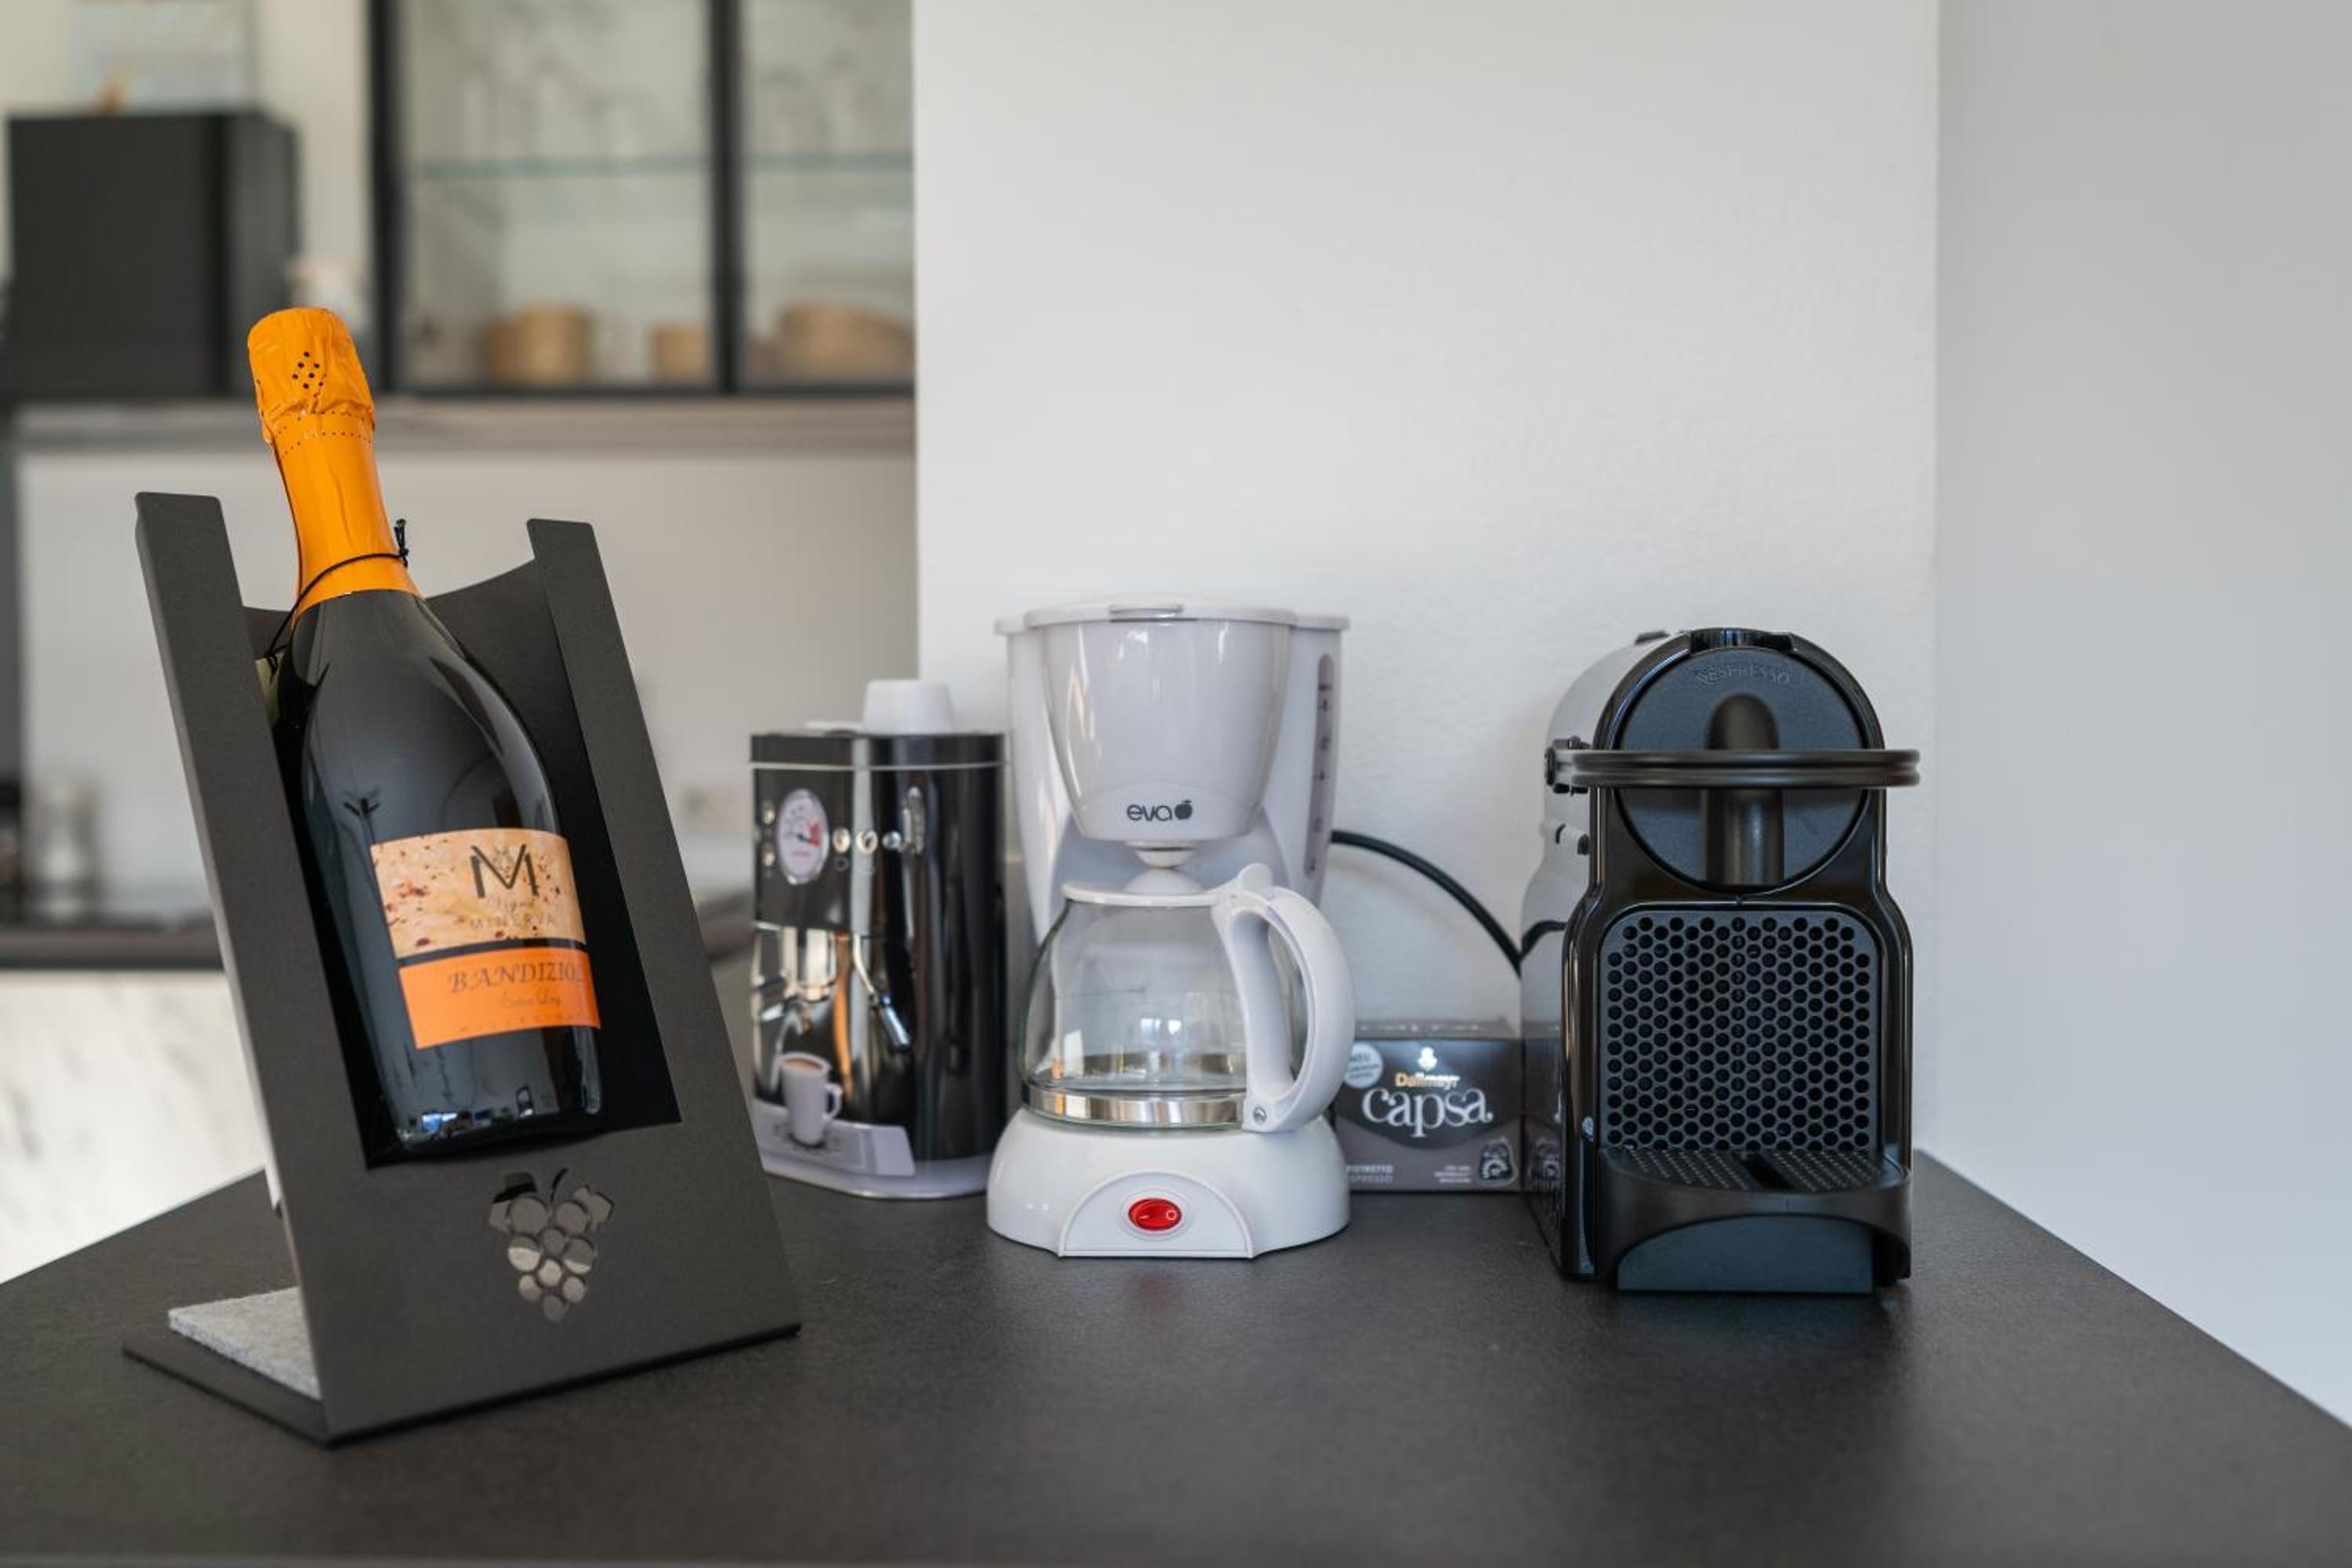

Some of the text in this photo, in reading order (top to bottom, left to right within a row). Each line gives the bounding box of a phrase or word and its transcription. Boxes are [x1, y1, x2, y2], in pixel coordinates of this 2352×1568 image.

[1694, 663, 1791, 685] NESPRESSO
[1127, 804, 1173, 822] eva
[470, 844, 539, 898] M
